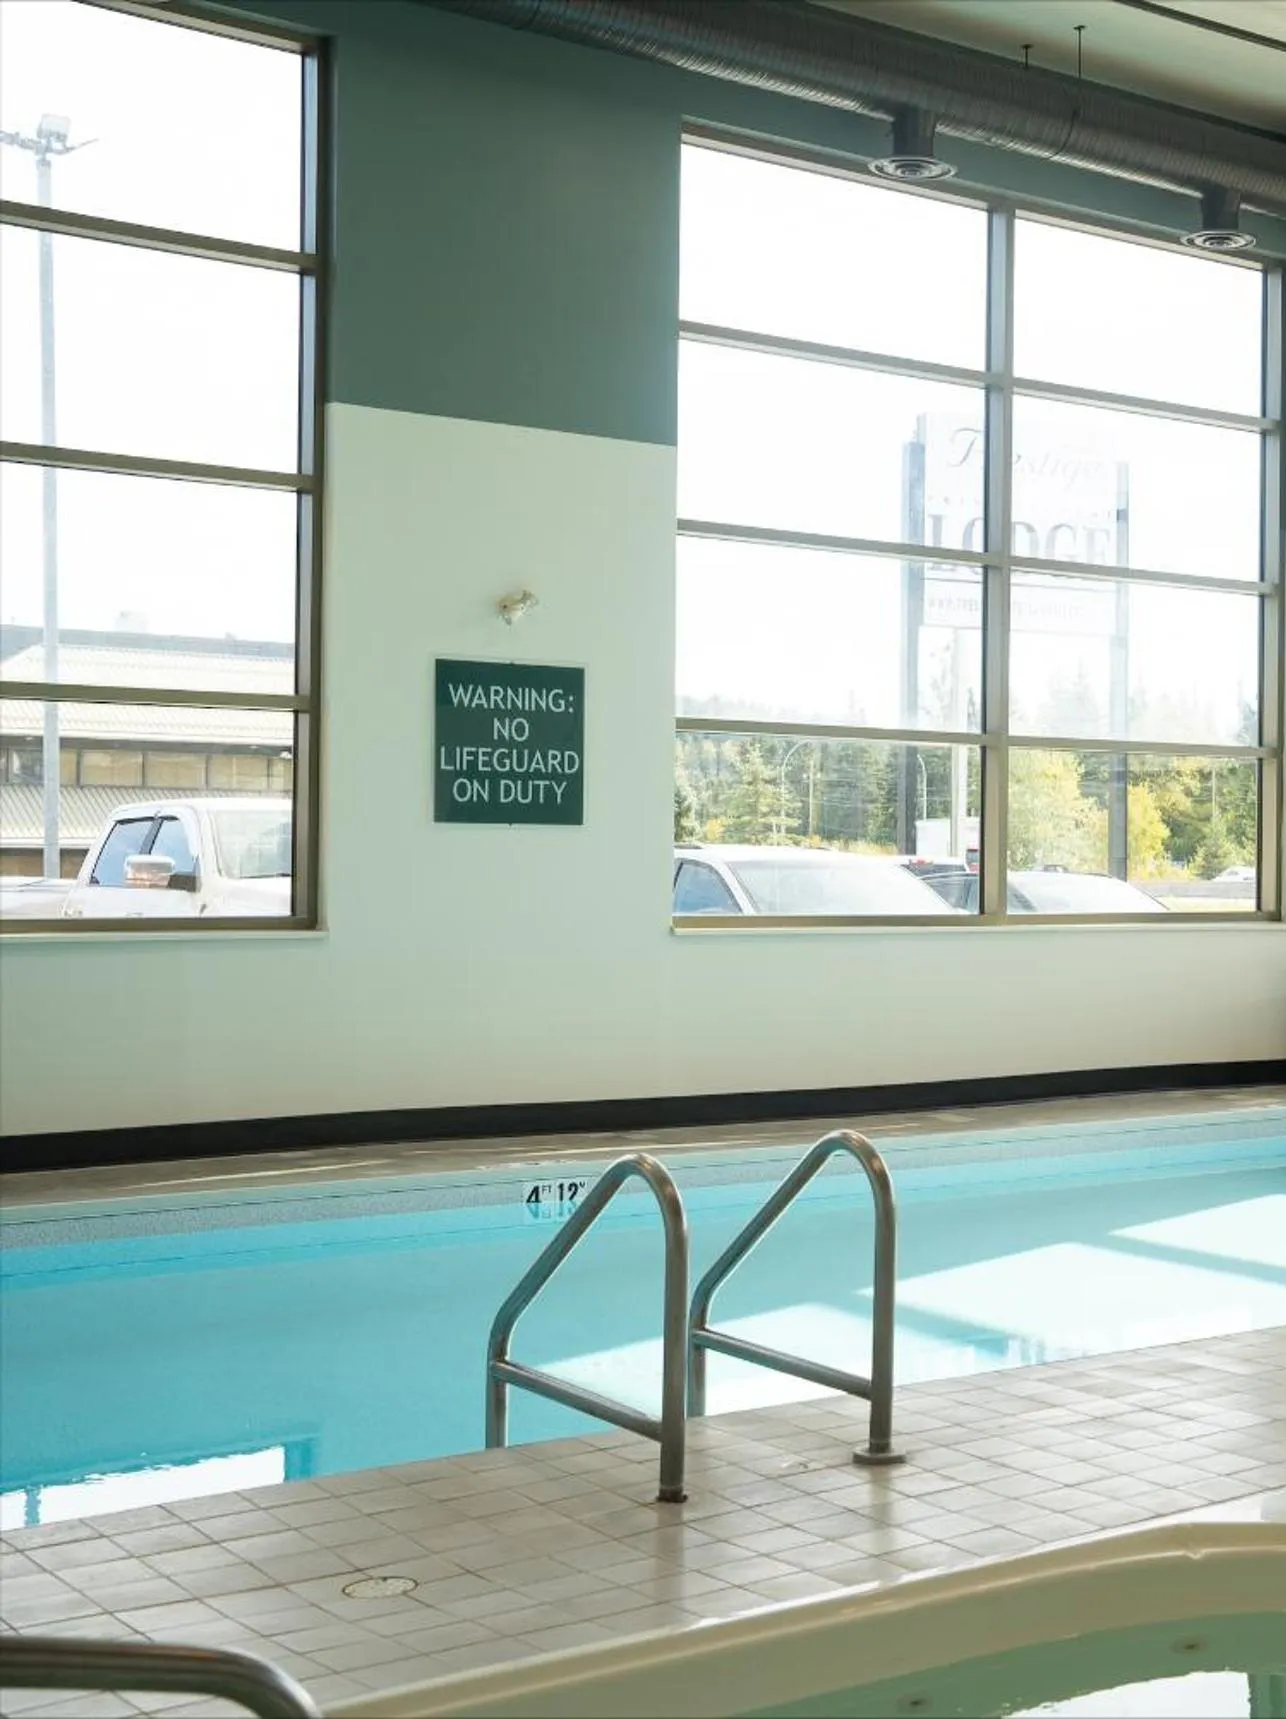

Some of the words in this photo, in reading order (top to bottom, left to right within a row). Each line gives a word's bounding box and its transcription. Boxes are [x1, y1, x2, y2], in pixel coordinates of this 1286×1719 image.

[448, 683, 574, 713] WARNING:
[493, 717, 529, 742] NO
[440, 746, 579, 774] LIFEGUARD
[452, 778, 489, 802] ON
[500, 779, 567, 804] DUTY
